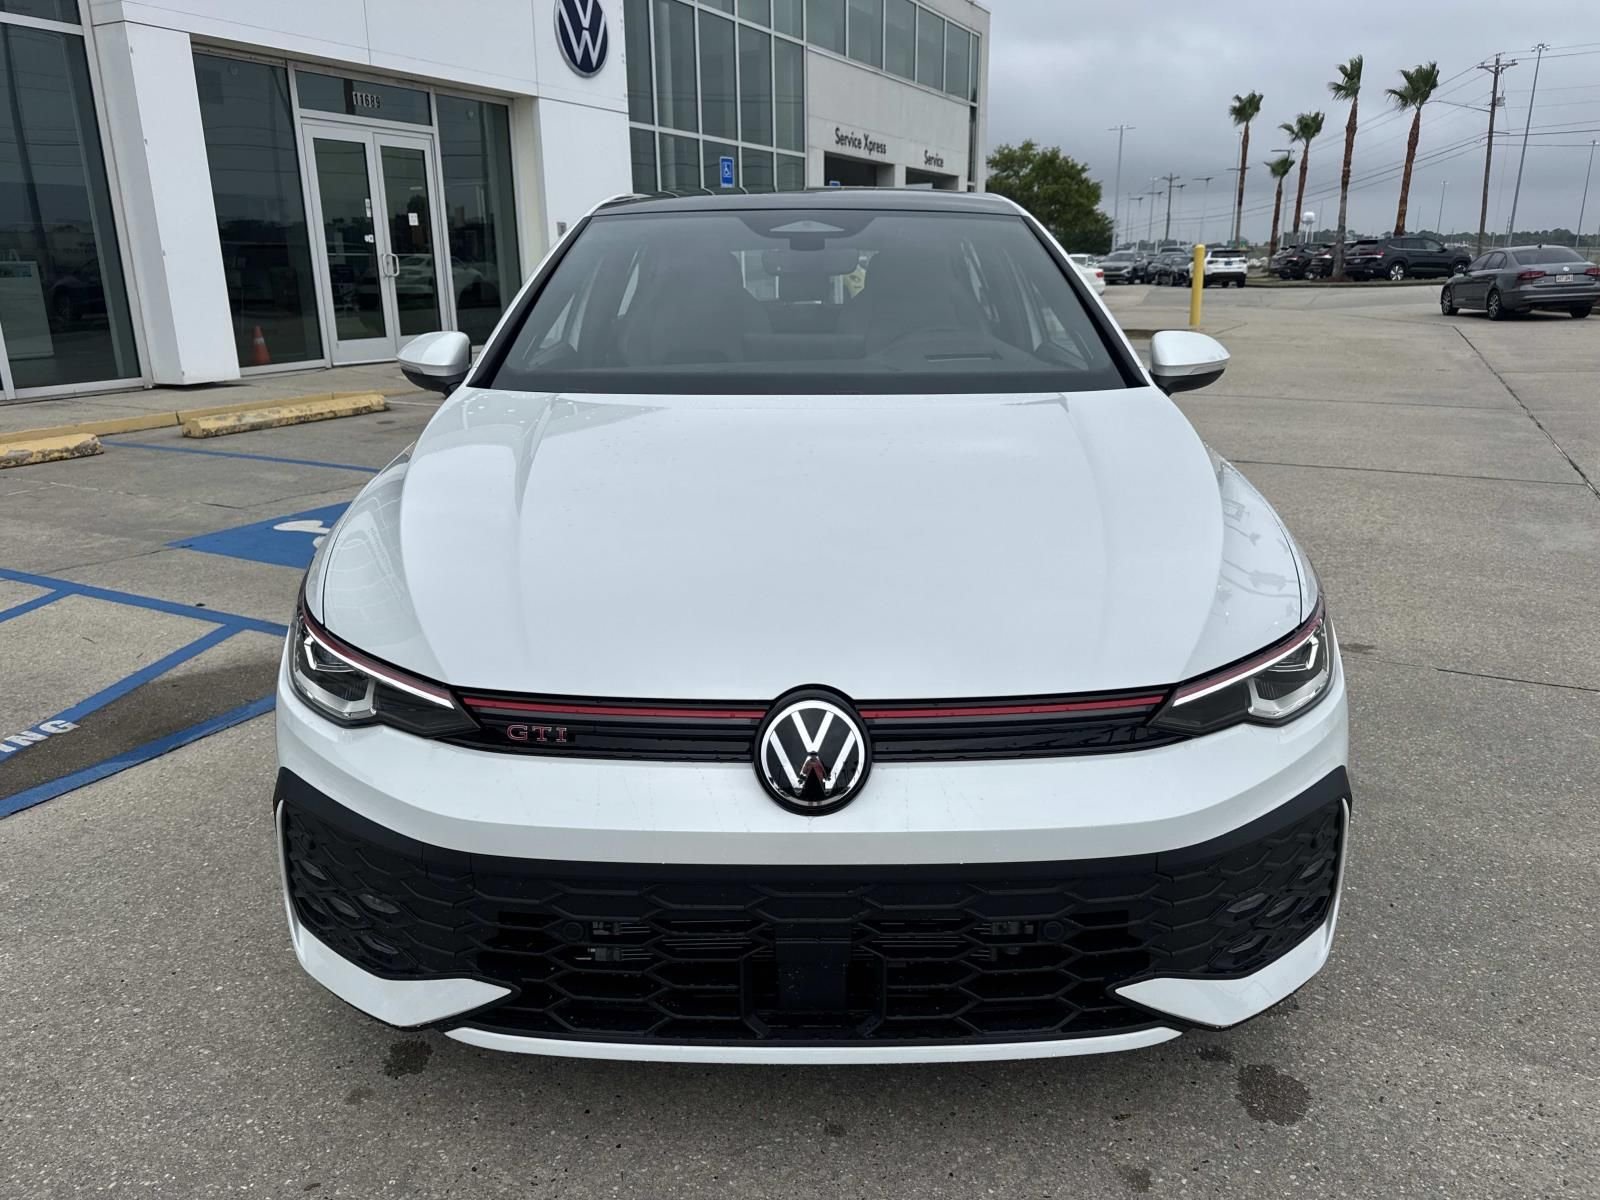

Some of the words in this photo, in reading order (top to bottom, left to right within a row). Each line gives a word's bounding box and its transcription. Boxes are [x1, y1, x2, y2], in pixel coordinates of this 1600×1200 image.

[353, 92, 381, 108] 11689
[835, 127, 862, 150] Service
[863, 133, 887, 155] Xpress
[924, 149, 944, 168] Service
[506, 724, 567, 743] GTI
[766, 705, 860, 799] VW
